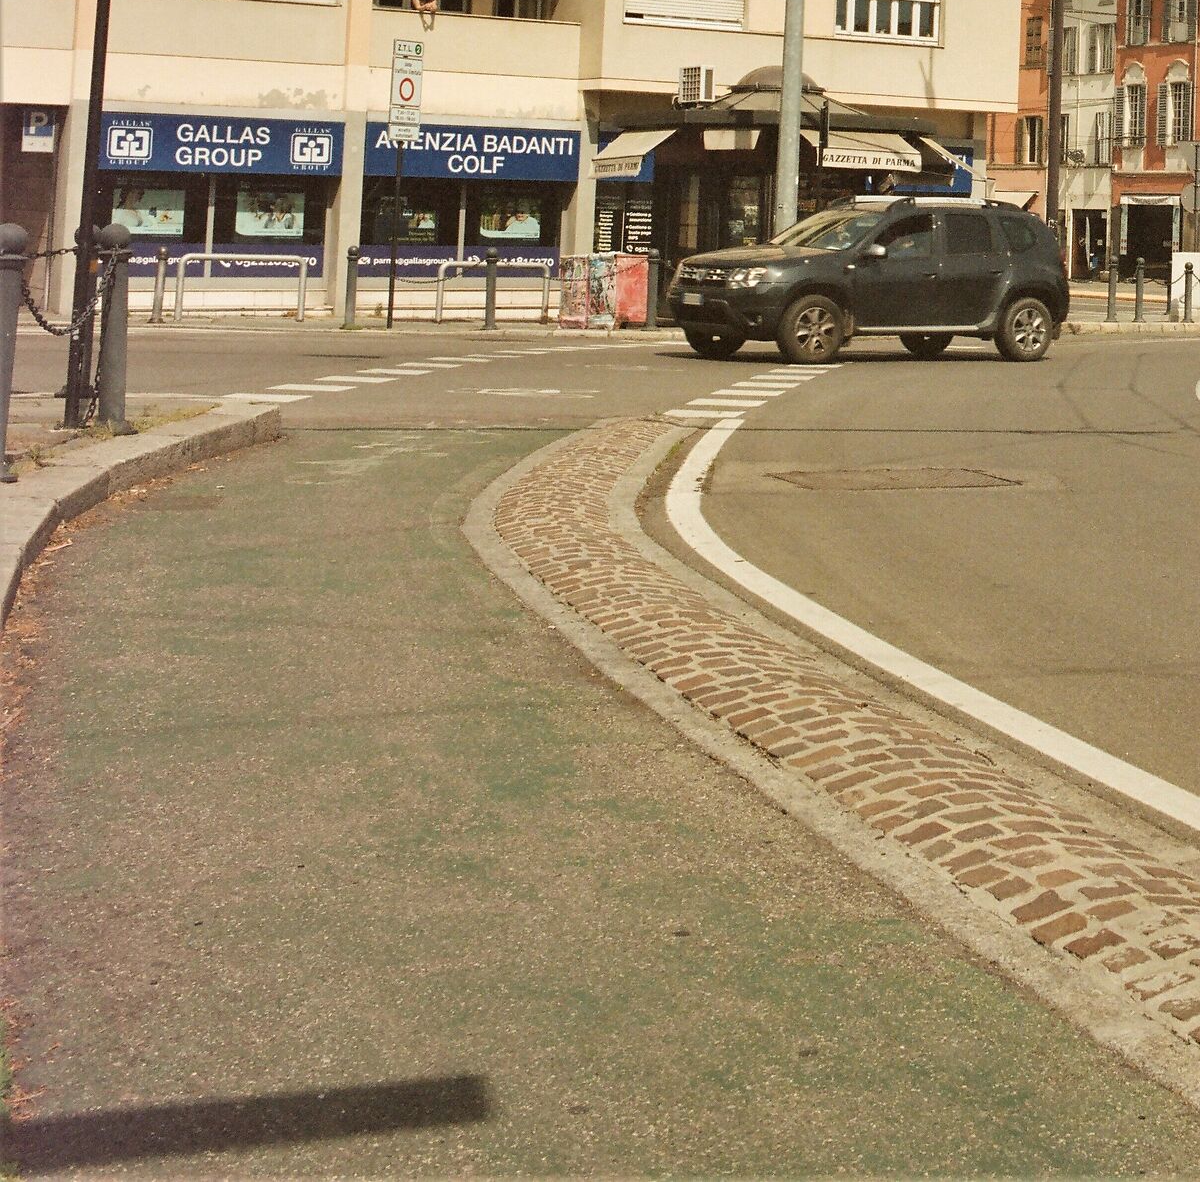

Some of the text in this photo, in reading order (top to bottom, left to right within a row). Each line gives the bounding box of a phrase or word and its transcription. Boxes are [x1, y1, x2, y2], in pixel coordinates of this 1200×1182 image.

[30, 112, 48, 134] P
[177, 124, 271, 145] GALLAS
[484, 135, 573, 155] BADANTI
[175, 147, 262, 167] GROUP
[448, 155, 505, 174] COLF
[823, 153, 916, 168] GAZZETTA DI PARMA
[373, 257, 454, 267] parm@gallasgroupit
